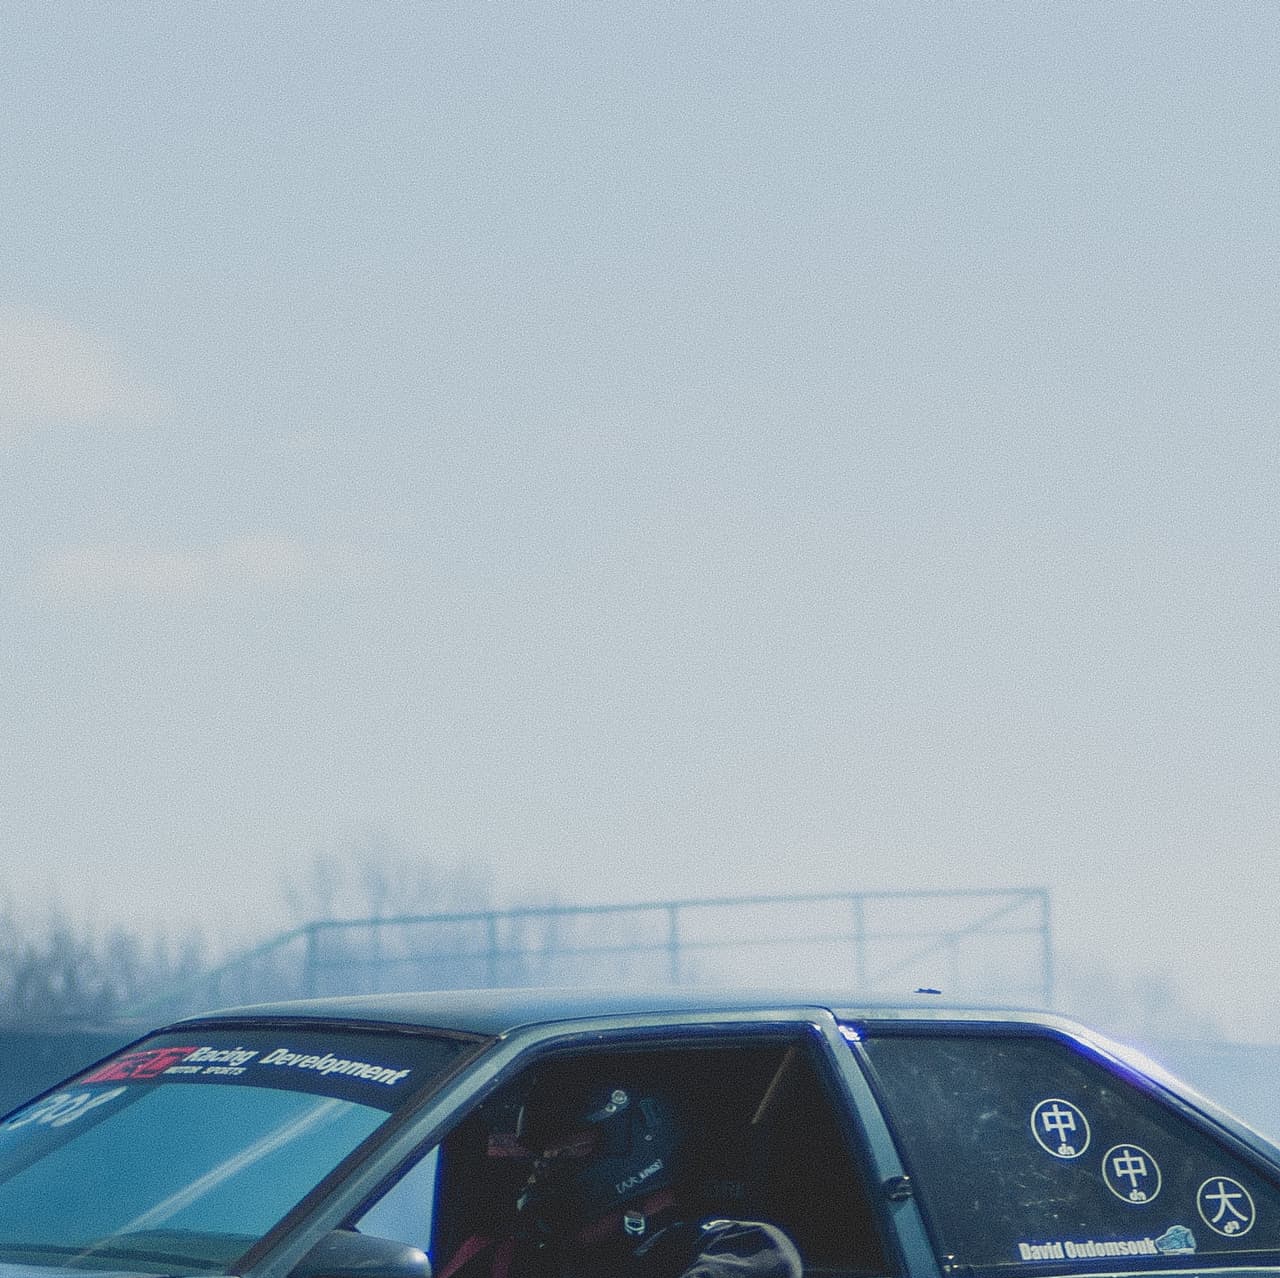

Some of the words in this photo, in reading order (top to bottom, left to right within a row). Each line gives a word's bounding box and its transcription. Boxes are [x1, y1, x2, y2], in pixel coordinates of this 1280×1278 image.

[183, 1046, 259, 1066] Racing
[260, 1048, 411, 1085] Development
[201, 1066, 247, 1075] SPORTS
[1041, 1104, 1076, 1142] 中
[1113, 1150, 1147, 1187] 中
[1205, 1182, 1248, 1223] 大
[1018, 1241, 1065, 1261] David
